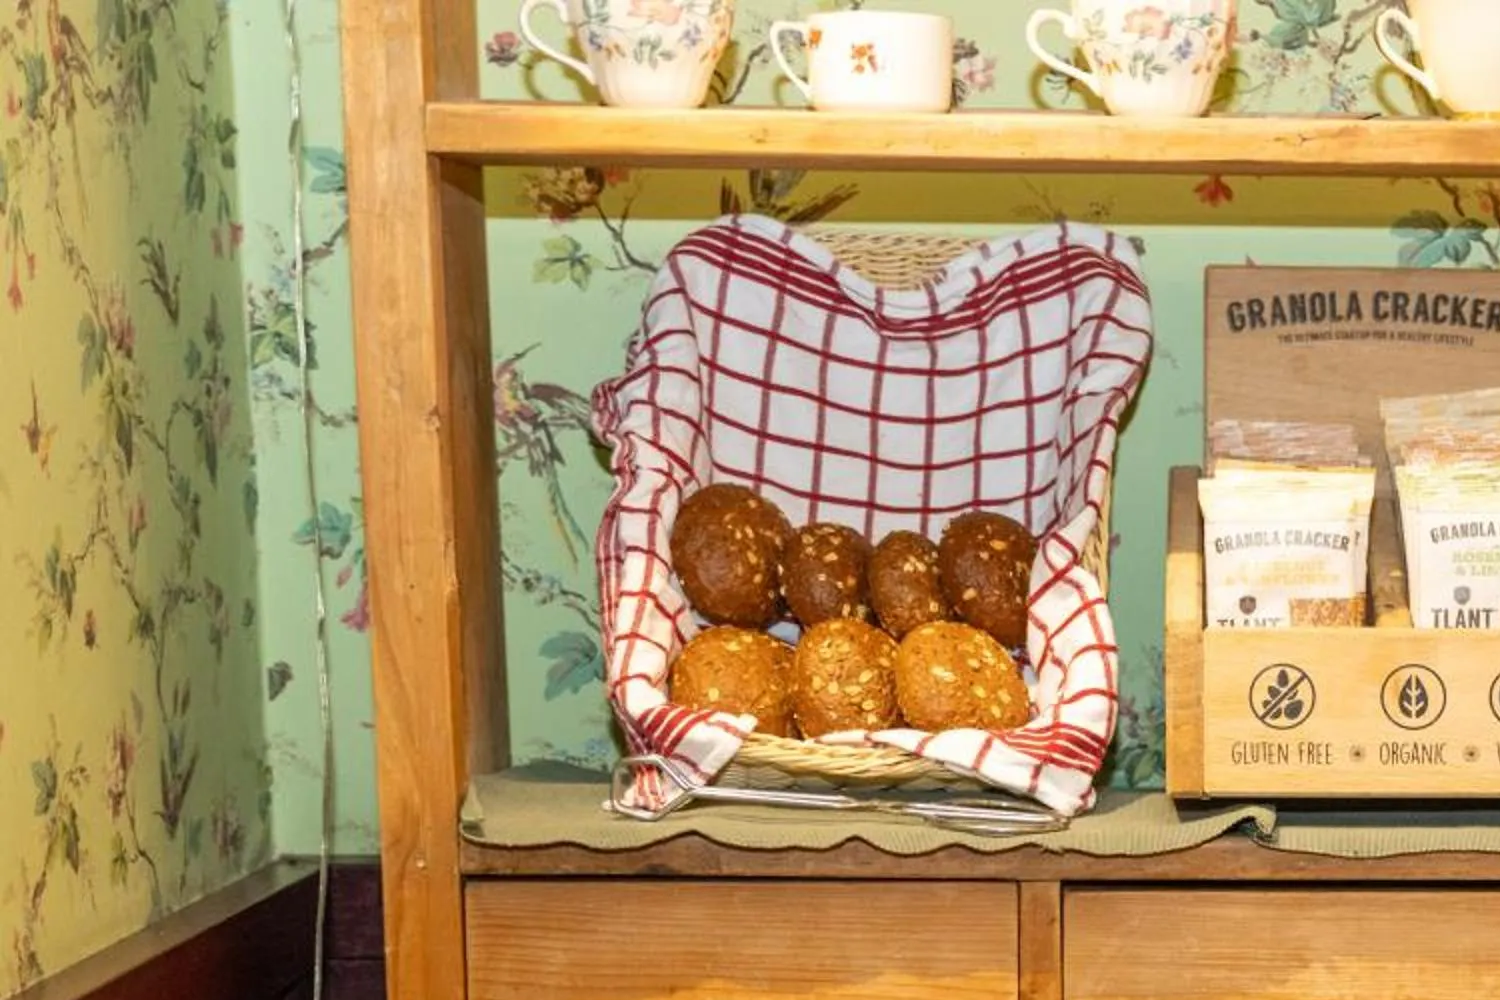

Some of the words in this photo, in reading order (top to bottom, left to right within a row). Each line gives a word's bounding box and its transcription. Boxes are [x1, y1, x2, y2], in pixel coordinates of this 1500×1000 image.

[1227, 291, 1362, 333] GRANOLA
[1215, 530, 1281, 554] GRANOLA
[1285, 530, 1350, 552] CRACKER
[1430, 521, 1496, 544] GRANOLA
[1231, 741, 1289, 766] GLUTEN
[1298, 741, 1333, 765] FREE
[1379, 741, 1448, 766] ORGANIC
